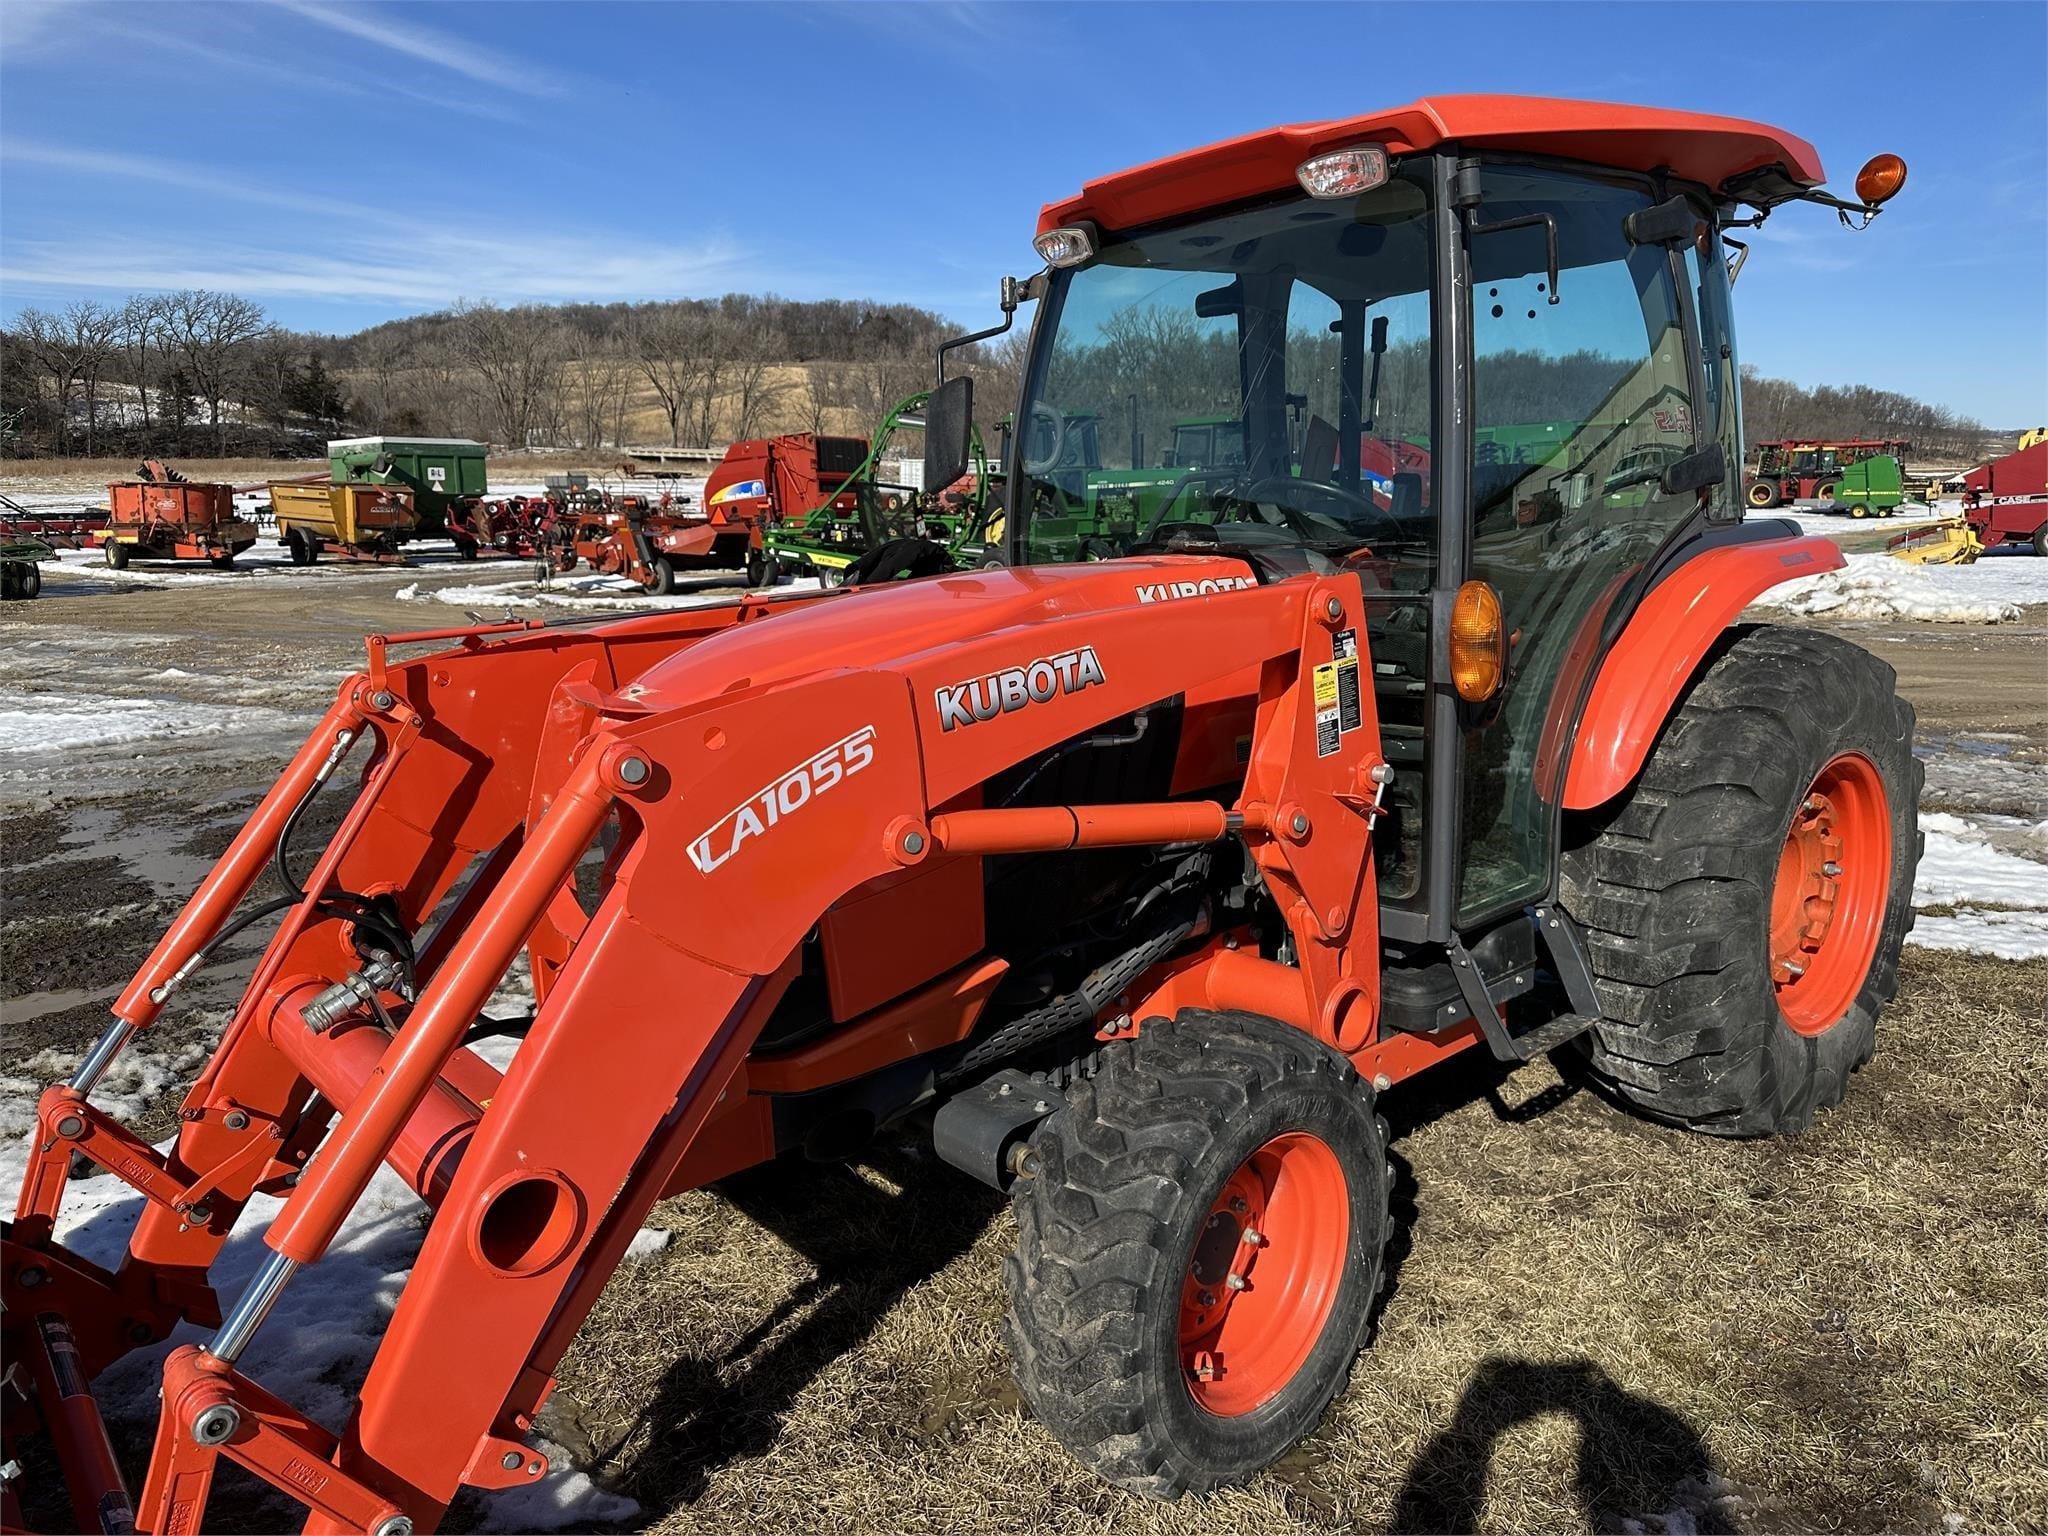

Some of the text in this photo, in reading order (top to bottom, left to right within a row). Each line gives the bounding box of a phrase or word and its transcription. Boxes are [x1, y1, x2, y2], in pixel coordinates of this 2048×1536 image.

[1998, 495, 2031, 505] CASE
[936, 647, 1105, 733] KUBOTA
[699, 731, 874, 874] LA1055
